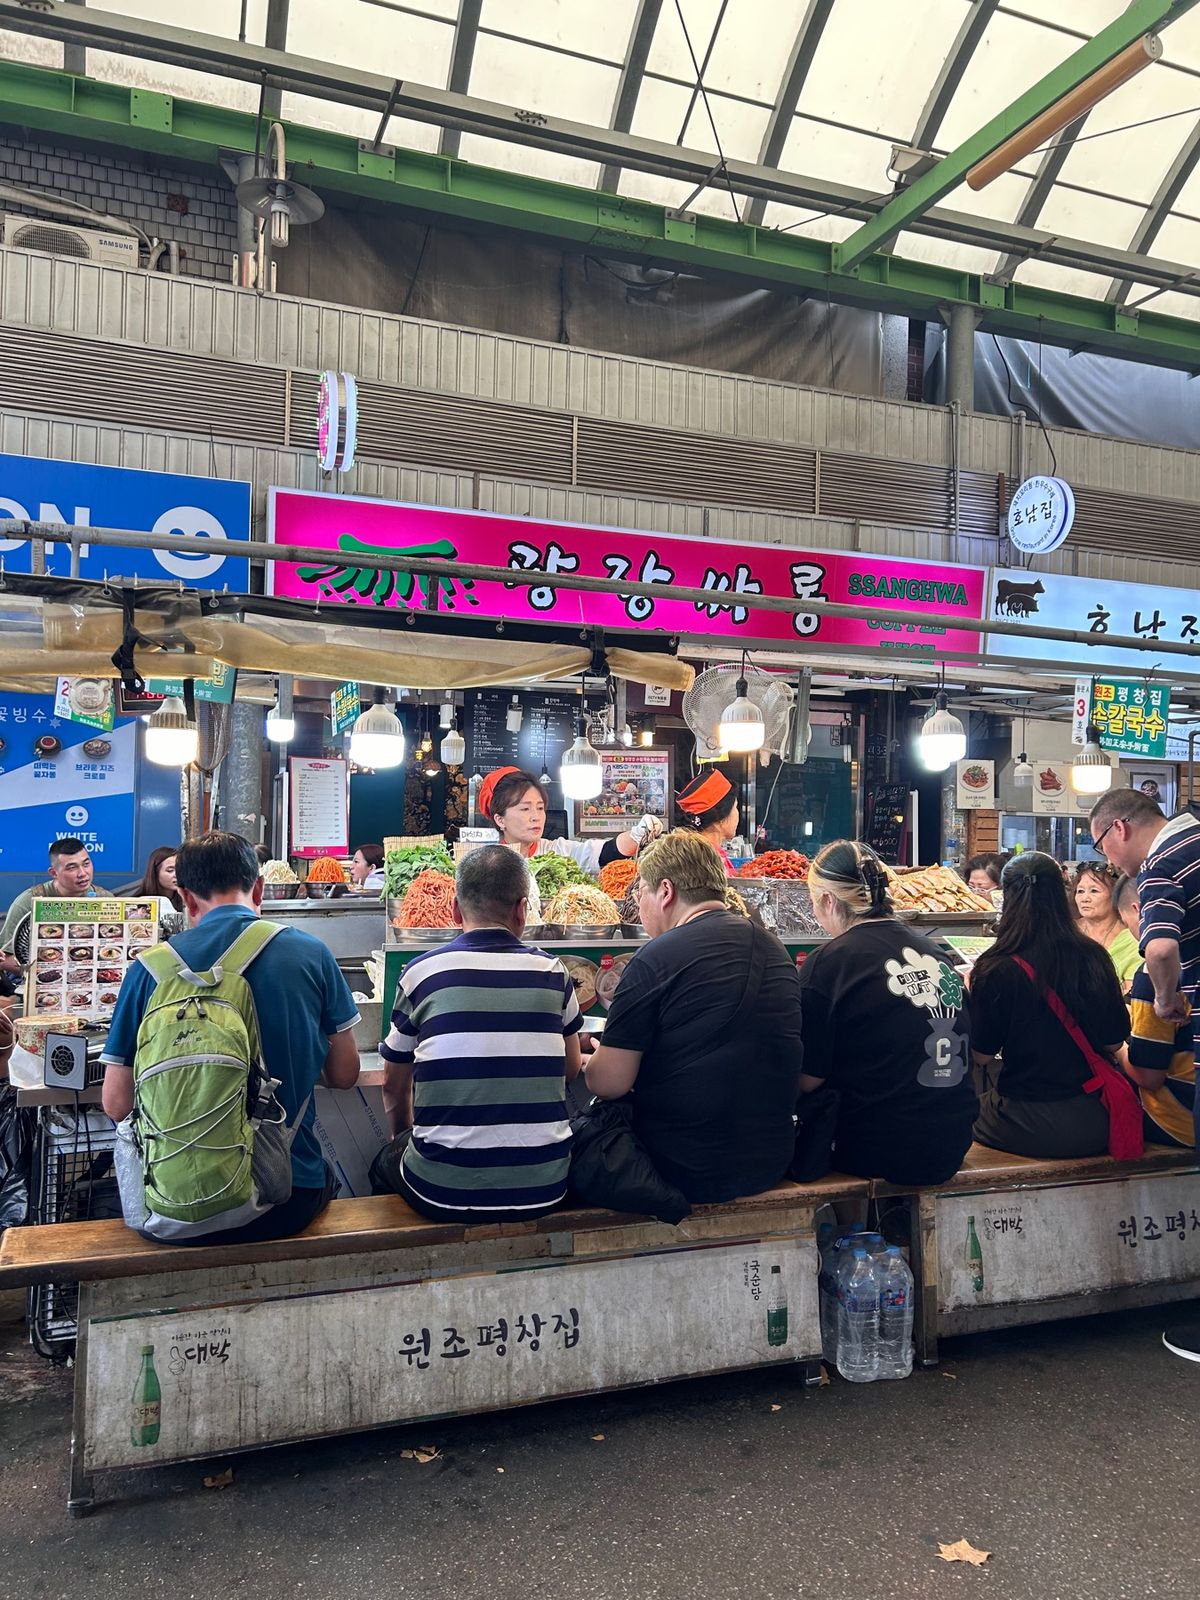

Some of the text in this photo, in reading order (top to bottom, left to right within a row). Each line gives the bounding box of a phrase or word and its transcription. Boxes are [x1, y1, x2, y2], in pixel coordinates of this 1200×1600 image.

[99, 239, 134, 251] SAMSUNG
[1013, 500, 1052, 527] 호남집
[848, 573, 968, 606] SSANGHWA
[61, 680, 70, 697] 2
[1094, 684, 1163, 706] 원조 평창집
[1076, 698, 1086, 717] 3
[1092, 702, 1166, 741] 손칼국수
[55, 831, 98, 842] WHITE
[936, 1038, 951, 1066] C
[993, 1215, 1023, 1234] 대박
[749, 1259, 763, 1301] 국순당
[184, 1338, 231, 1365] 대박
[398, 1307, 580, 1370] 원조평창집
